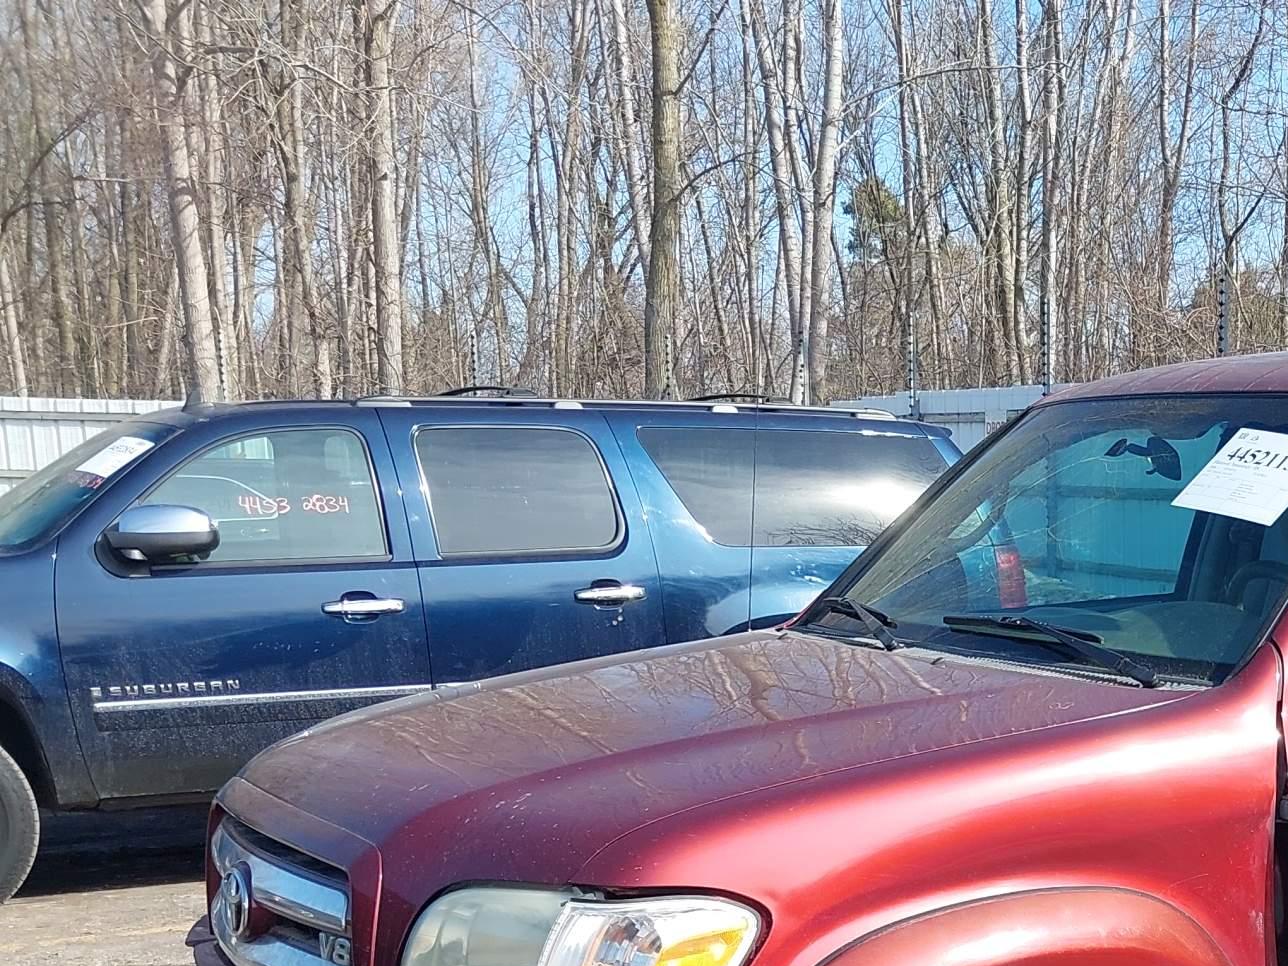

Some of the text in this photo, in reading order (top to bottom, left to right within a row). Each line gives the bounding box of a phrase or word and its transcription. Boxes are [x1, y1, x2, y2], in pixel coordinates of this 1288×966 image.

[238, 494, 350, 515] 4453 2834
[109, 679, 240, 696] SUBURBAN
[318, 932, 351, 966] V8
